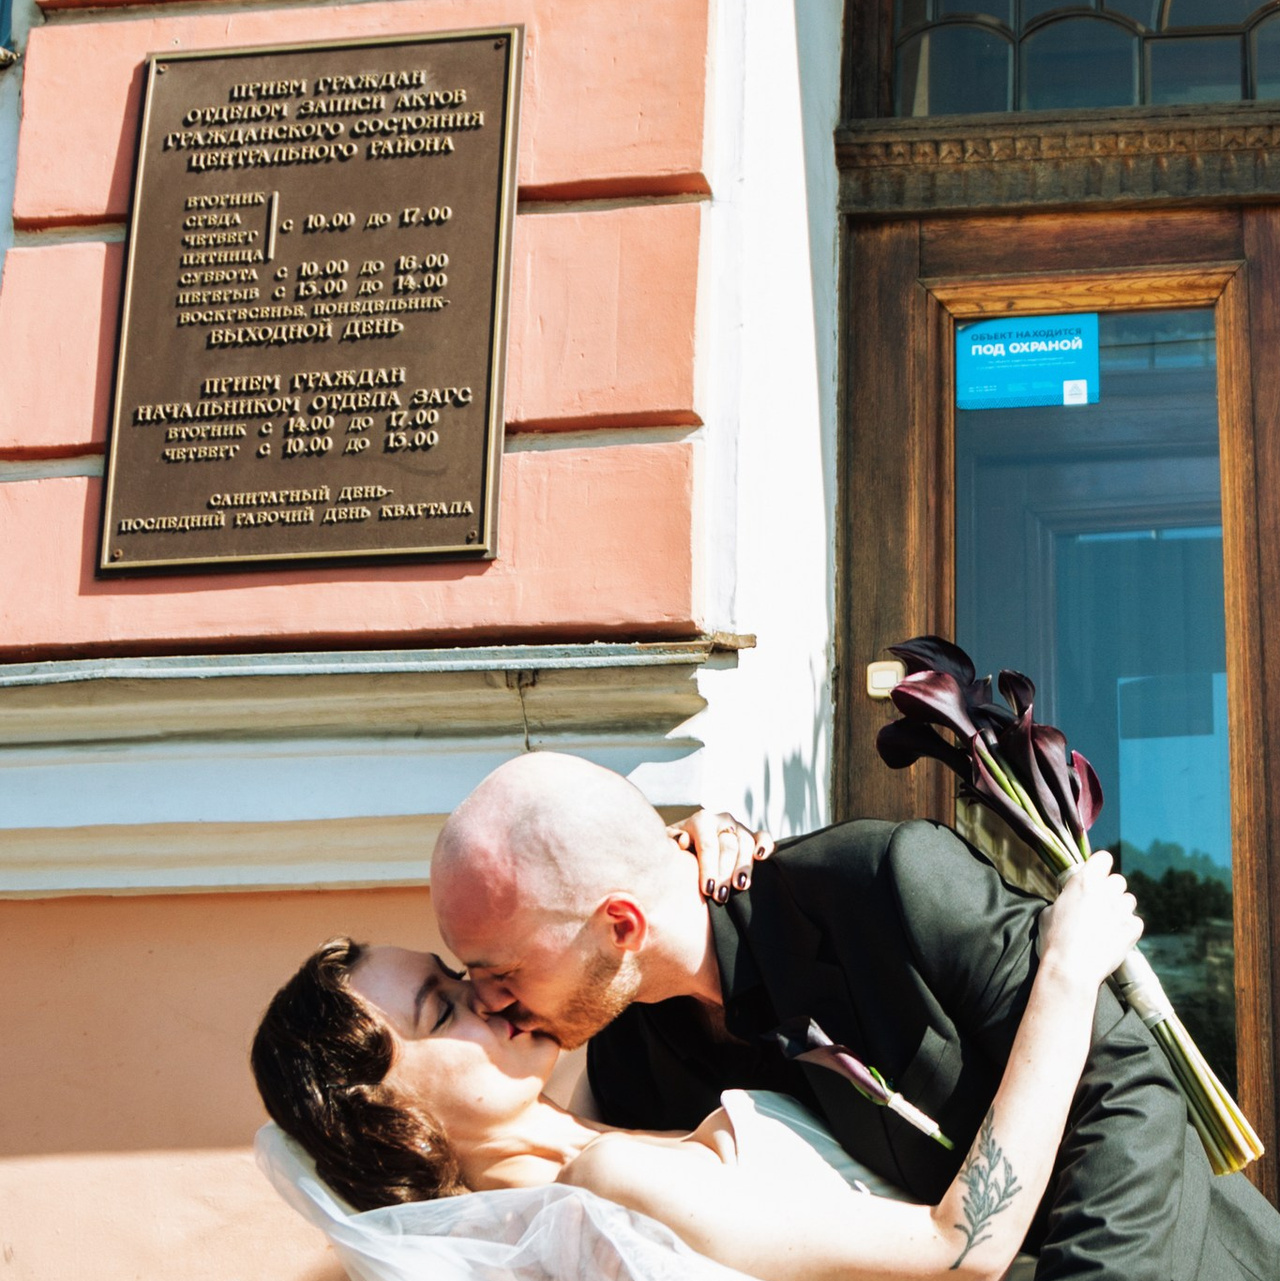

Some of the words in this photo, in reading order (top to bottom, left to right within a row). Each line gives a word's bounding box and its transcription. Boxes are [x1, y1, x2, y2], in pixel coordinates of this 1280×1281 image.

[231, 79, 307, 99] ПРИЕМ
[318, 70, 427, 91] ГРАЖДАН
[187, 103, 288, 123] ОТДЕЛОМ
[300, 96, 386, 114] ЗАПИСИ
[397, 89, 467, 108] АКТОВ
[166, 122, 344, 147] ГРАЖДАНСКОГО
[354, 111, 484, 132] СОСТОЯНИЯ
[190, 142, 358, 169] ЦЕНТРАЛЬНОГО
[370, 135, 455, 155] РАЙОНА
[187, 192, 265, 208] ВТОРНИК
[186, 214, 241, 227] СРЕДА
[306, 213, 356, 229] 10.00
[402, 206, 452, 223] 17.00
[184, 231, 259, 247] ЧЕТВЕРГ
[180, 269, 259, 284] СУББОТА
[300, 260, 349, 277] 10.00
[399, 253, 449, 270] 16.00
[182, 249, 263, 265] ПЯТНИЦА
[178, 288, 259, 305] ПЕРЕРЫВ
[397, 273, 448, 290] 14.00
[211, 319, 333, 344] ВЫХОДНОЙ
[344, 318, 404, 337] ДЕНЬ
[971, 331, 1012, 341] ОБЪЕКТ
[1016, 327, 1081, 339] НАХОДИТСЯ
[972, 344, 1005, 356] ПОД
[1009, 337, 1082, 353] ОХРАНОЙ
[205, 375, 281, 394] ПРИЕМ
[292, 368, 406, 388] ГРАЖДАН
[137, 396, 301, 421] НАЧАЛЬНИКОМ
[312, 391, 401, 410] ОТДЕЛА
[414, 387, 472, 404] ЗАГС
[167, 424, 246, 440] ВТОРНИК
[288, 416, 334, 434] 14.00
[389, 409, 439, 428] 17.00
[164, 445, 240, 461] ЧЕТВЕРГ
[285, 437, 333, 453] 10.00
[209, 485, 331, 507] САНИТАРНЫЙ
[119, 511, 225, 532] ПОСЛЕДНИЙ
[235, 507, 315, 527] РАБОЧИЙ
[324, 507, 371, 521] ДЕНЬ
[381, 501, 473, 518] КВАРТАЛА
